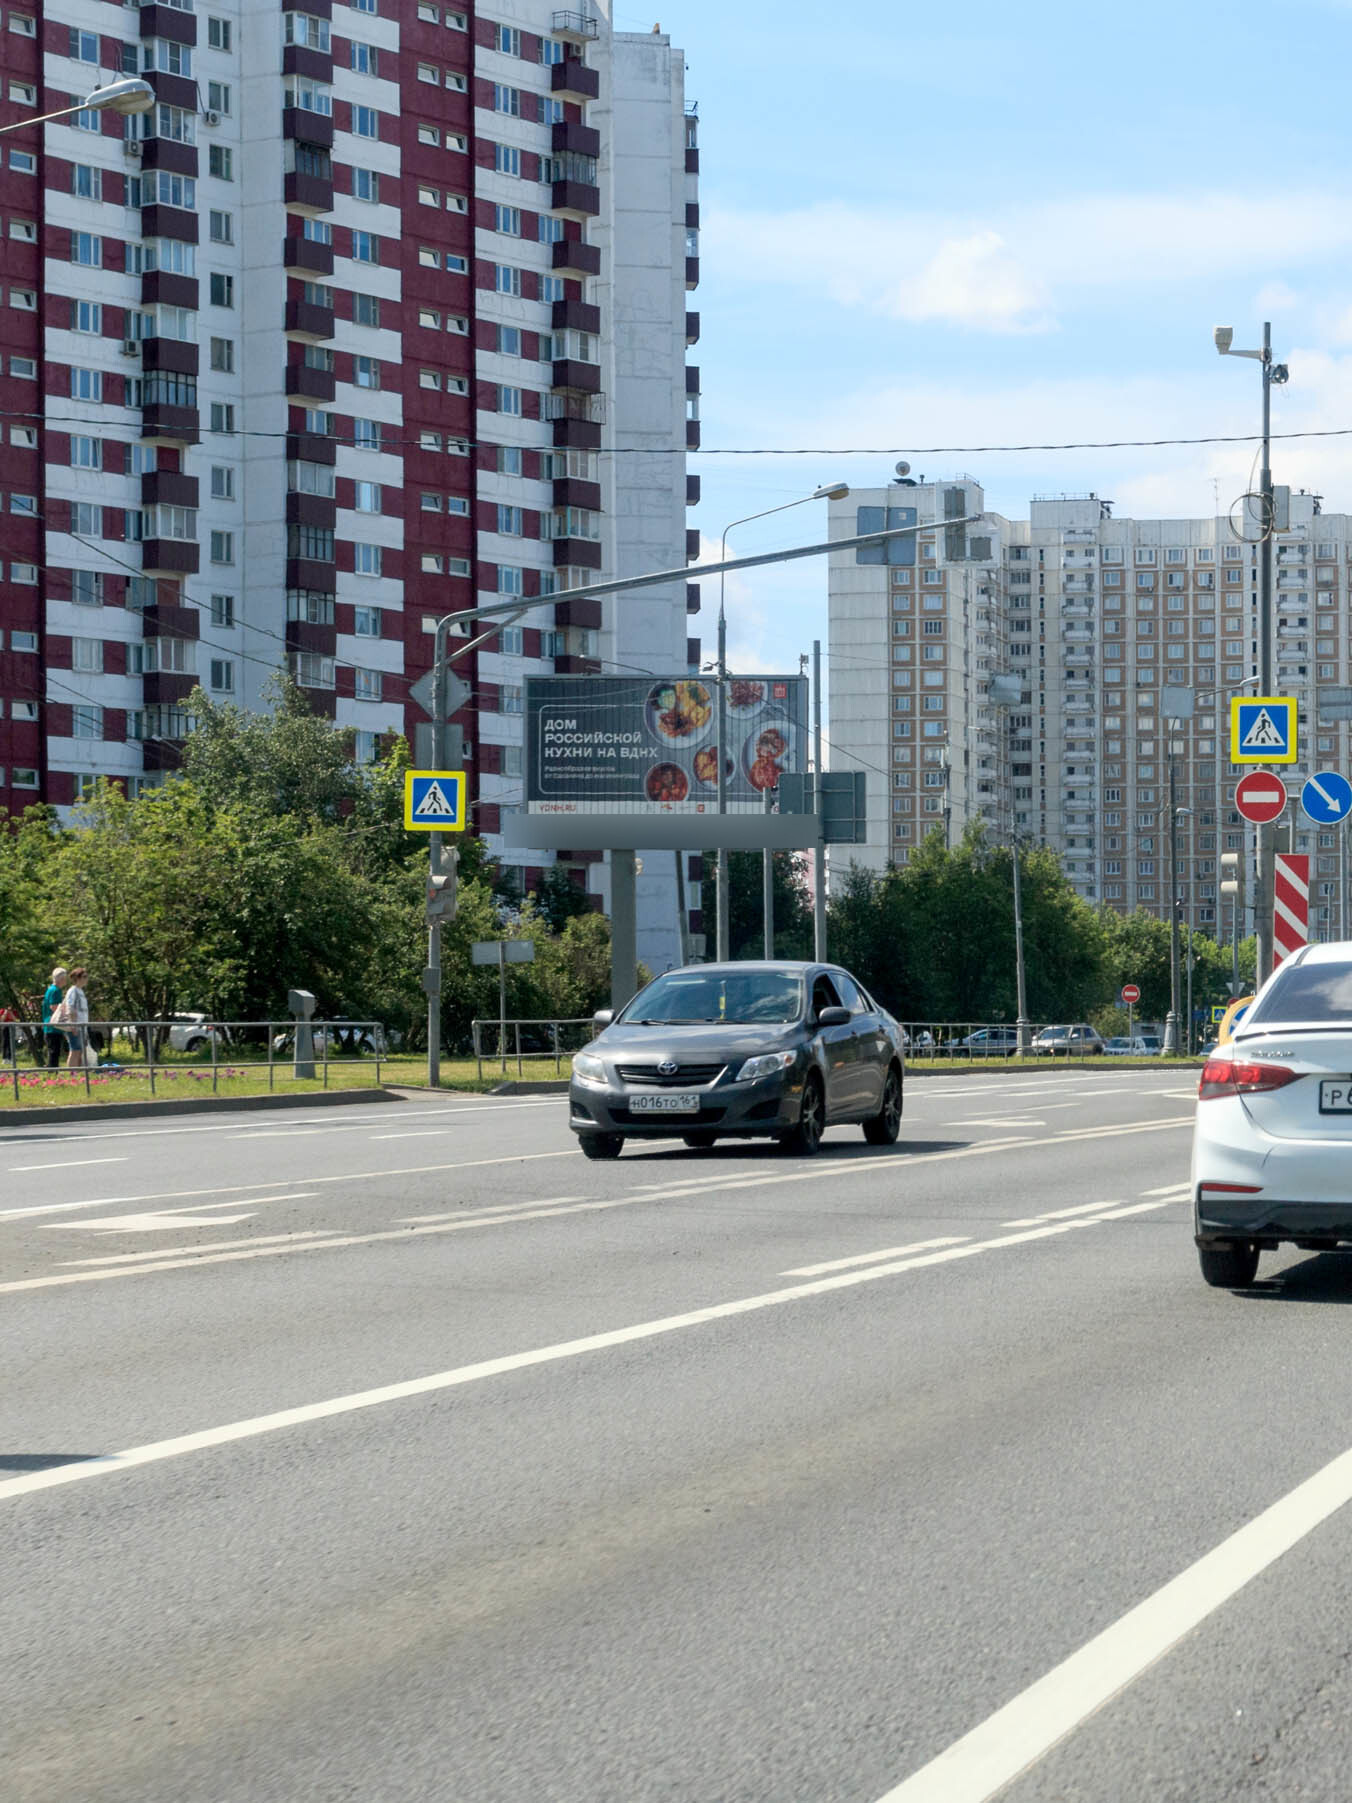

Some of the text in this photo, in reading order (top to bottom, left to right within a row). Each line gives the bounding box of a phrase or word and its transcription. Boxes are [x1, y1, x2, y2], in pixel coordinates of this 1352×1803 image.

[544, 719, 577, 731] ДОМ
[597, 747, 616, 758] НА
[620, 747, 659, 760] ВДНХ
